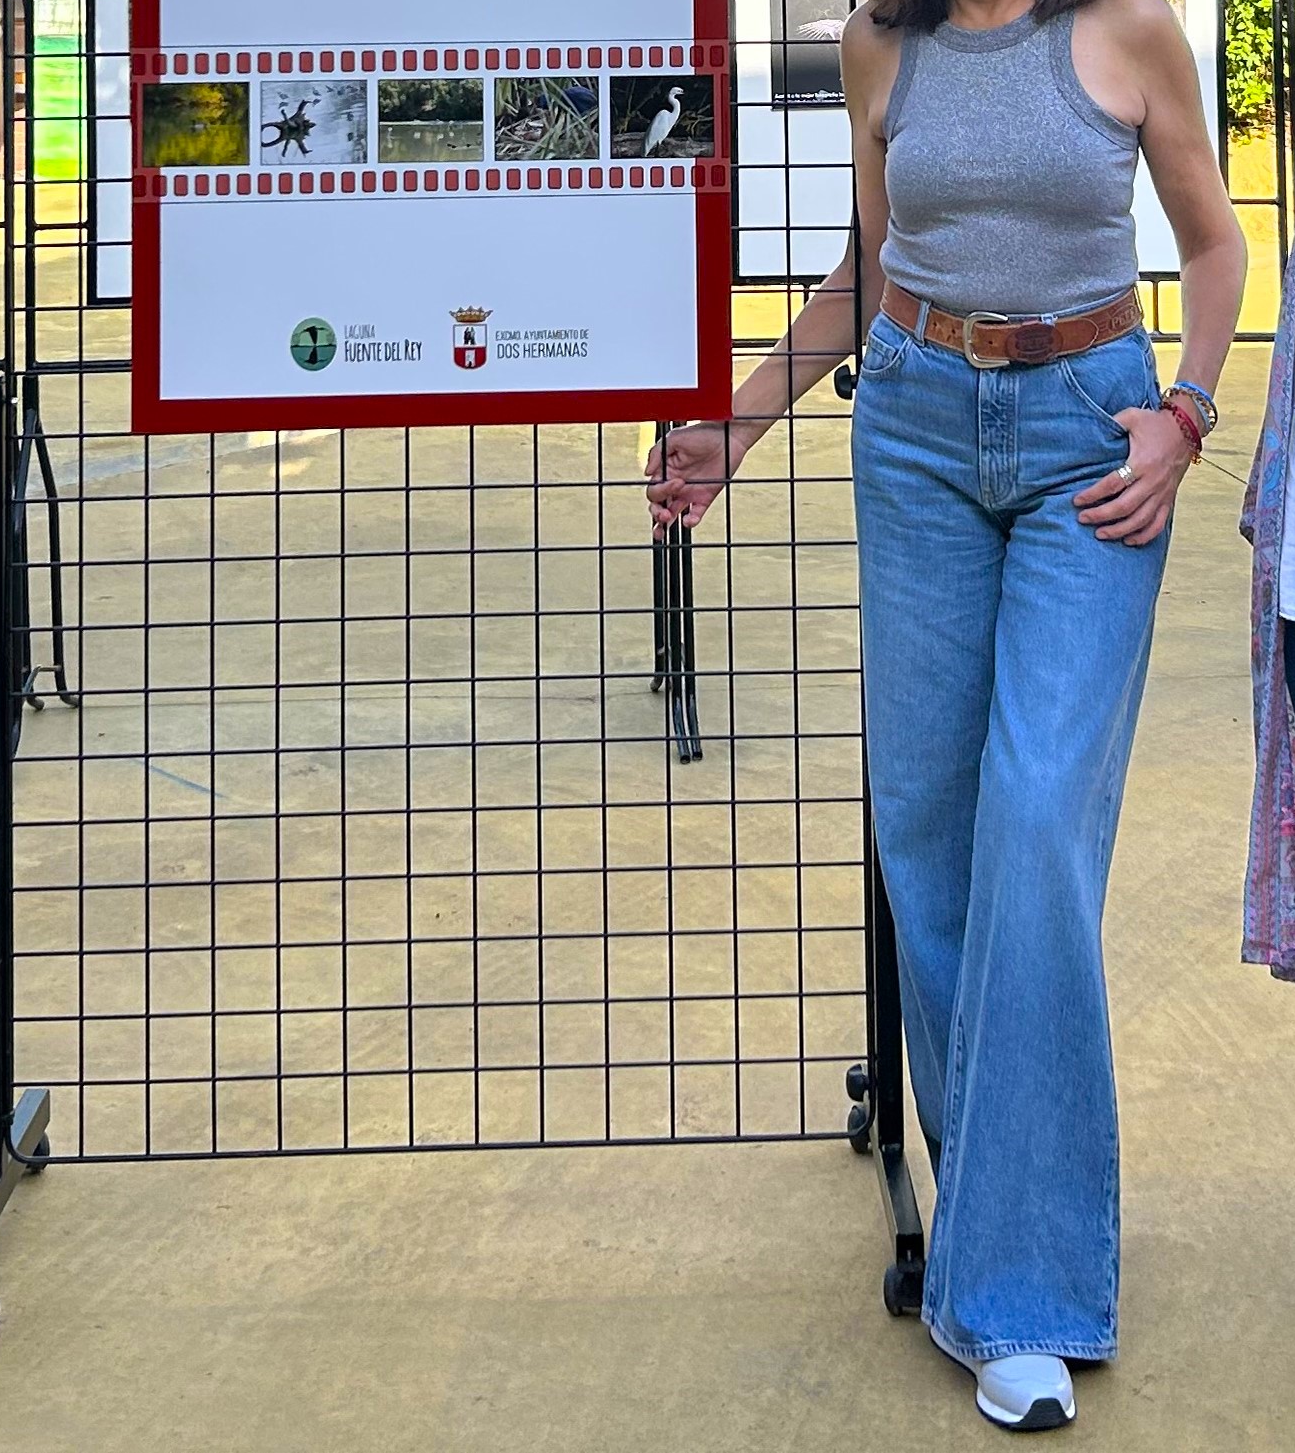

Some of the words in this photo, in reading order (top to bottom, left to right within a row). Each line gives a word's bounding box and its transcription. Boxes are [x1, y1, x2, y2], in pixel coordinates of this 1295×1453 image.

[344, 324, 376, 340] LAGUNA
[524, 329, 579, 341] AYUNTAMIENTO
[580, 329, 590, 340] DE
[344, 340, 382, 362] FUENTE
[384, 341, 402, 362] DEL
[497, 343, 521, 360] DOS
[523, 341, 588, 359] HERMANAS
